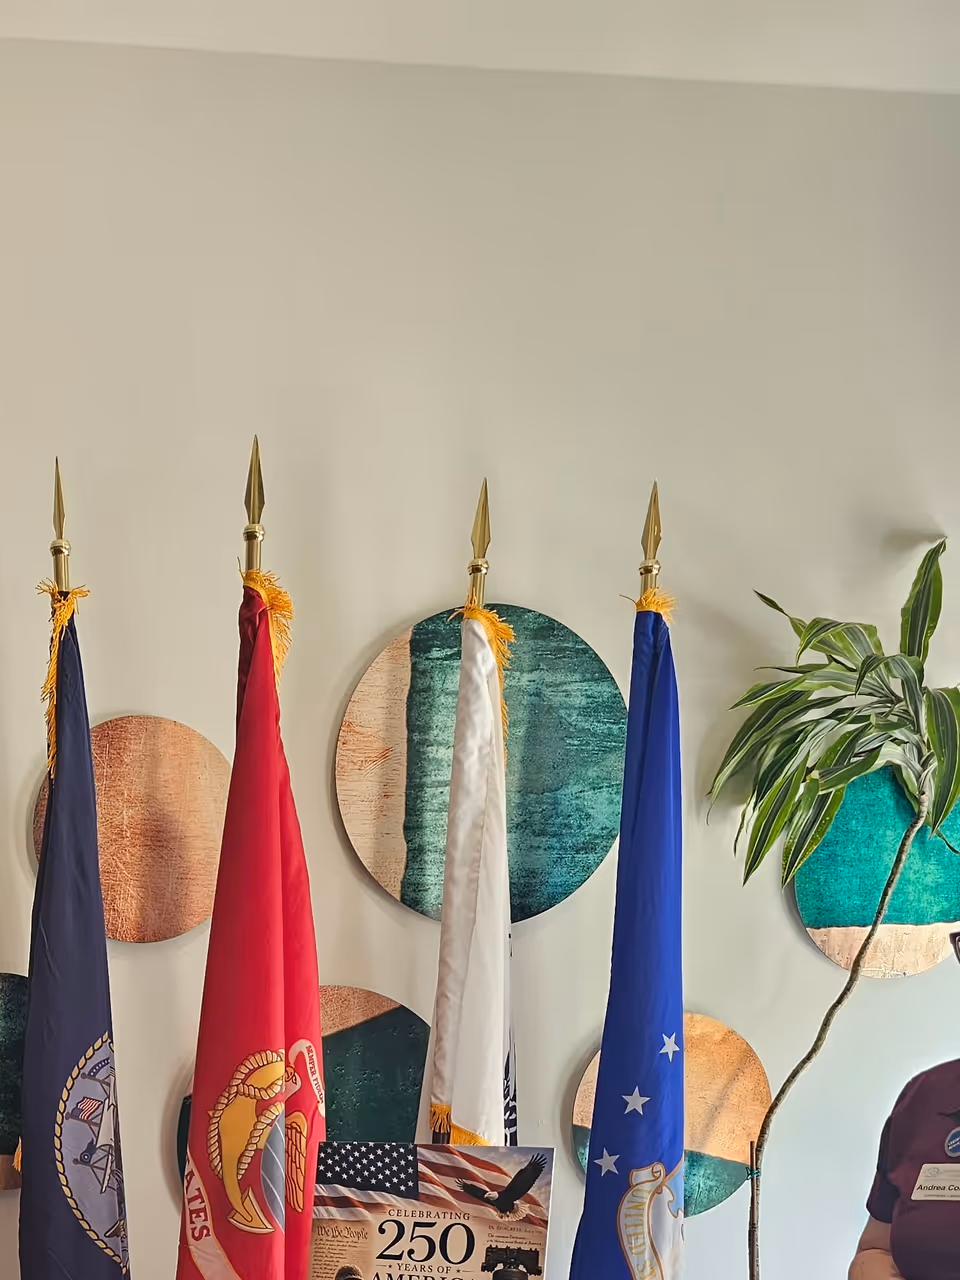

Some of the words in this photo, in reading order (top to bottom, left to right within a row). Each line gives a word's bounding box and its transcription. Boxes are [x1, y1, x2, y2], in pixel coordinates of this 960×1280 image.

[184, 1157, 212, 1243] ATES
[388, 1209, 471, 1220] CELEBRATING
[343, 1226, 368, 1240] People
[624, 1188, 653, 1257] UNITED
[375, 1219, 475, 1265] 250
[397, 1263, 433, 1274] YEARS
[436, 1265, 452, 1274] OF
